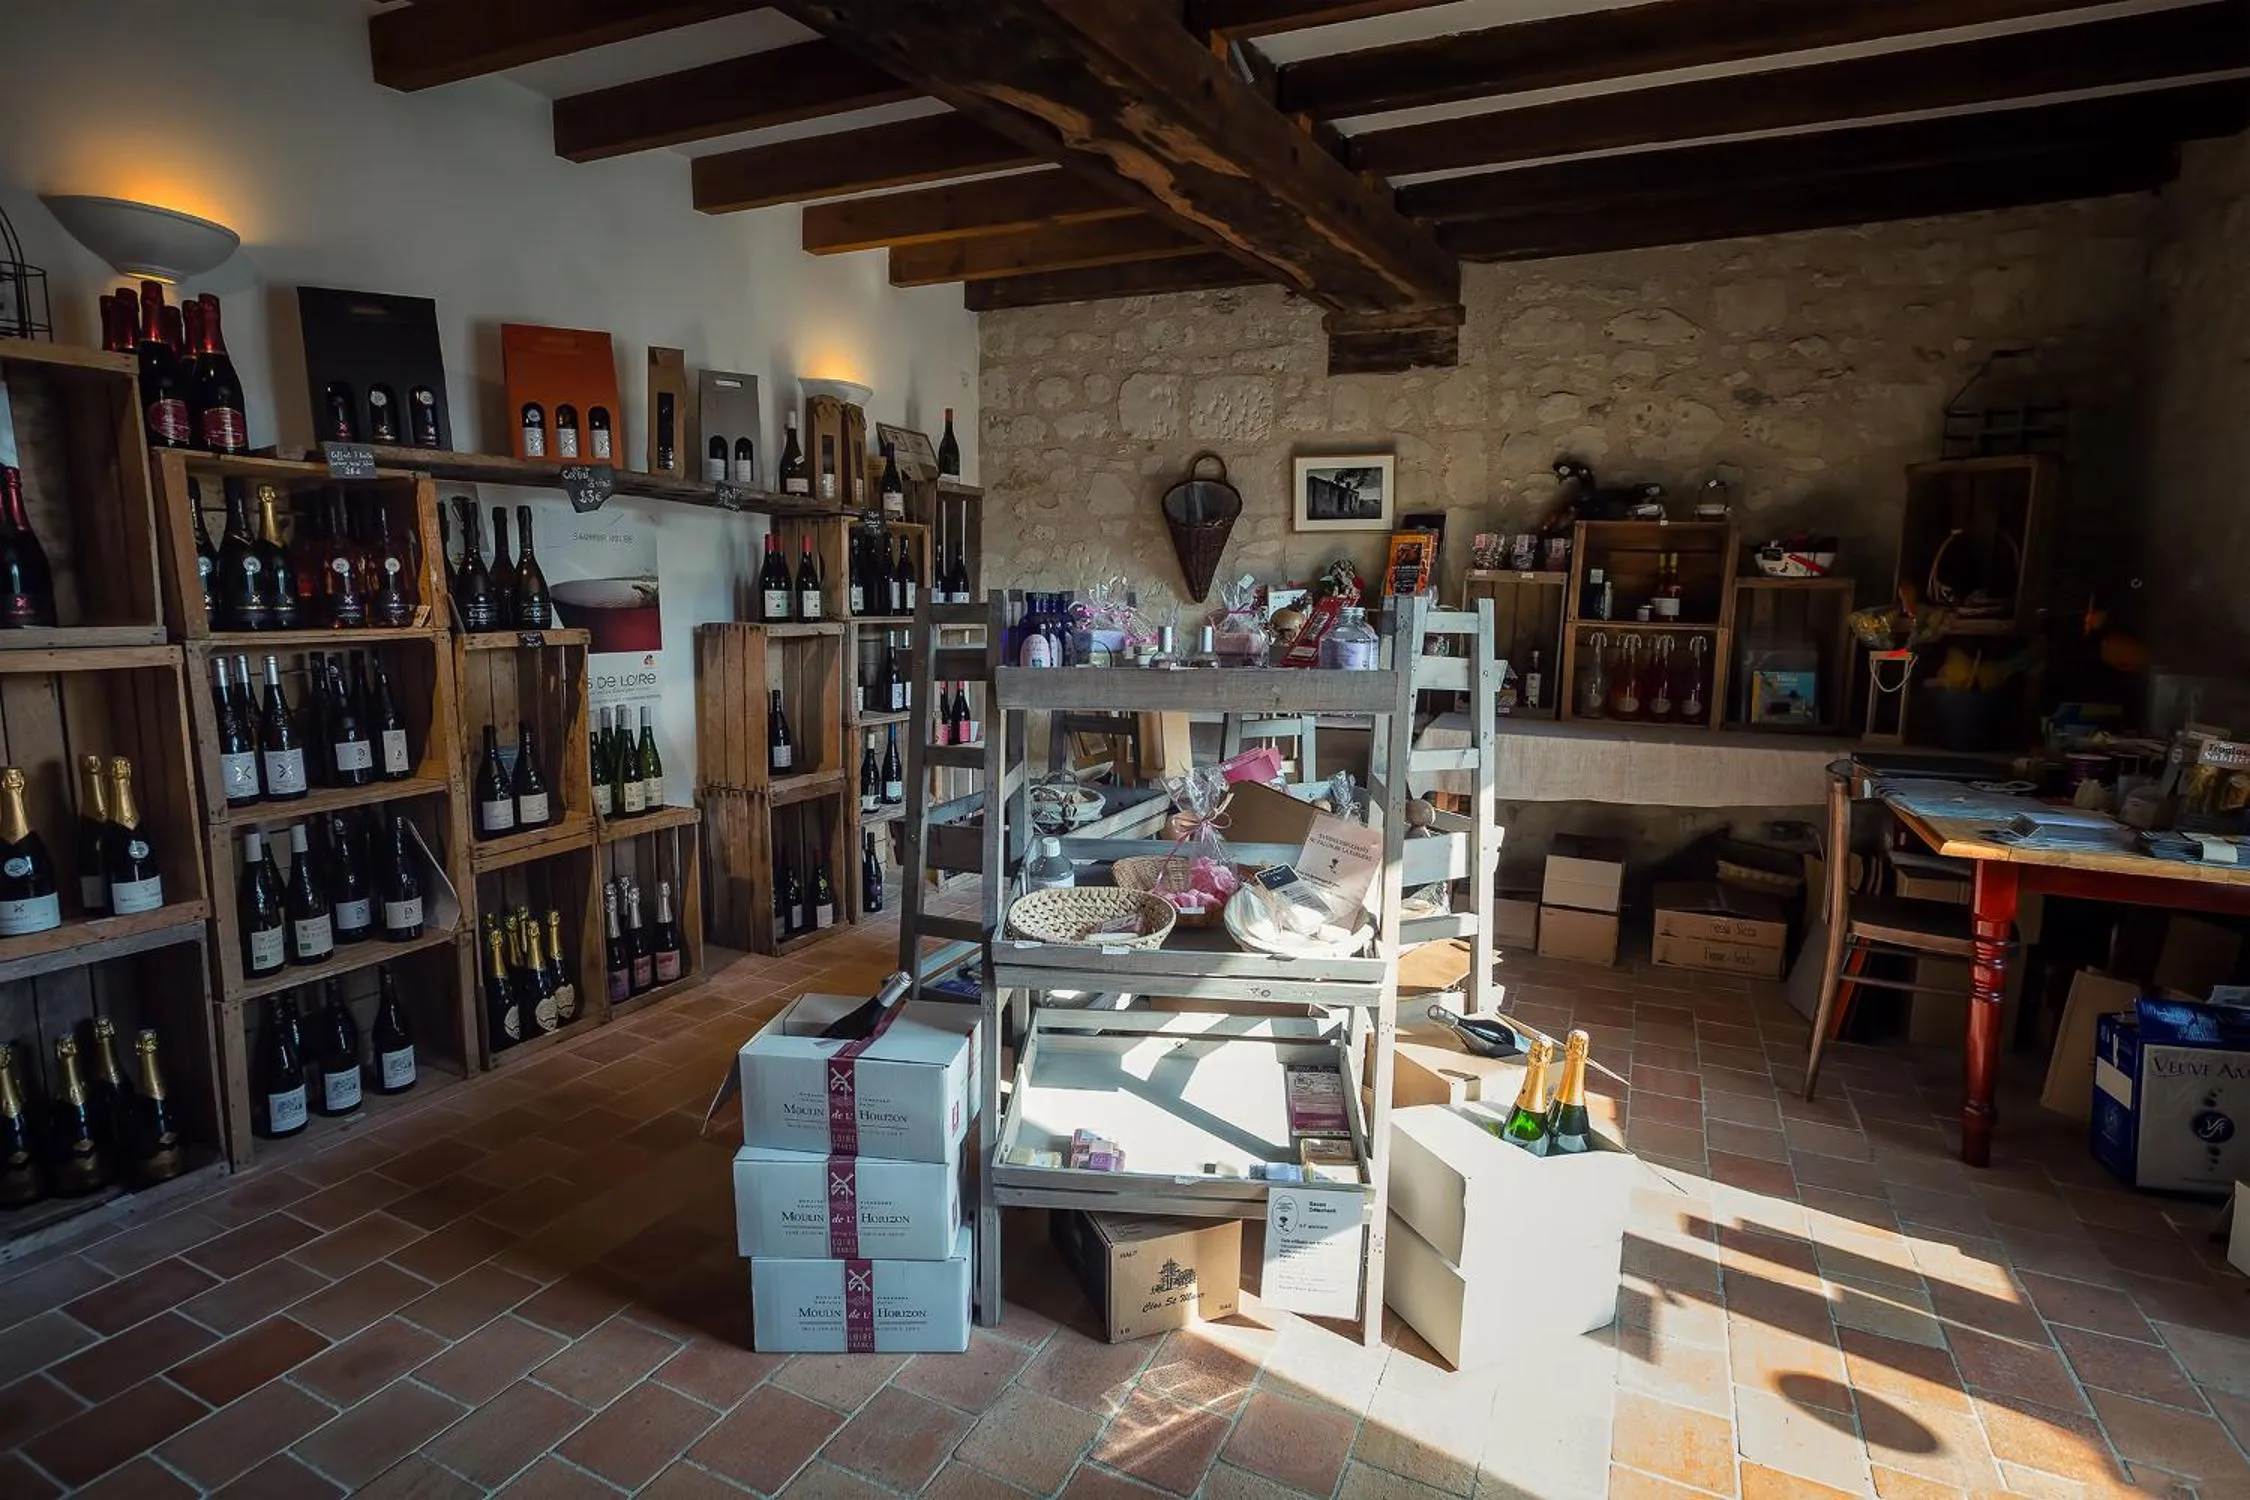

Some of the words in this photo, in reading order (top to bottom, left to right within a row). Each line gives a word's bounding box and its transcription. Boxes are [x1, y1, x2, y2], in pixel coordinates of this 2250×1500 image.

[783, 1103, 825, 1117] MOULIN
[860, 1110, 909, 1123] HORIZON
[782, 1212, 825, 1222] MOULIN
[861, 1213, 911, 1224] HORIZON
[798, 1307, 842, 1318] MOULIN
[877, 1308, 927, 1318] HORIZON
